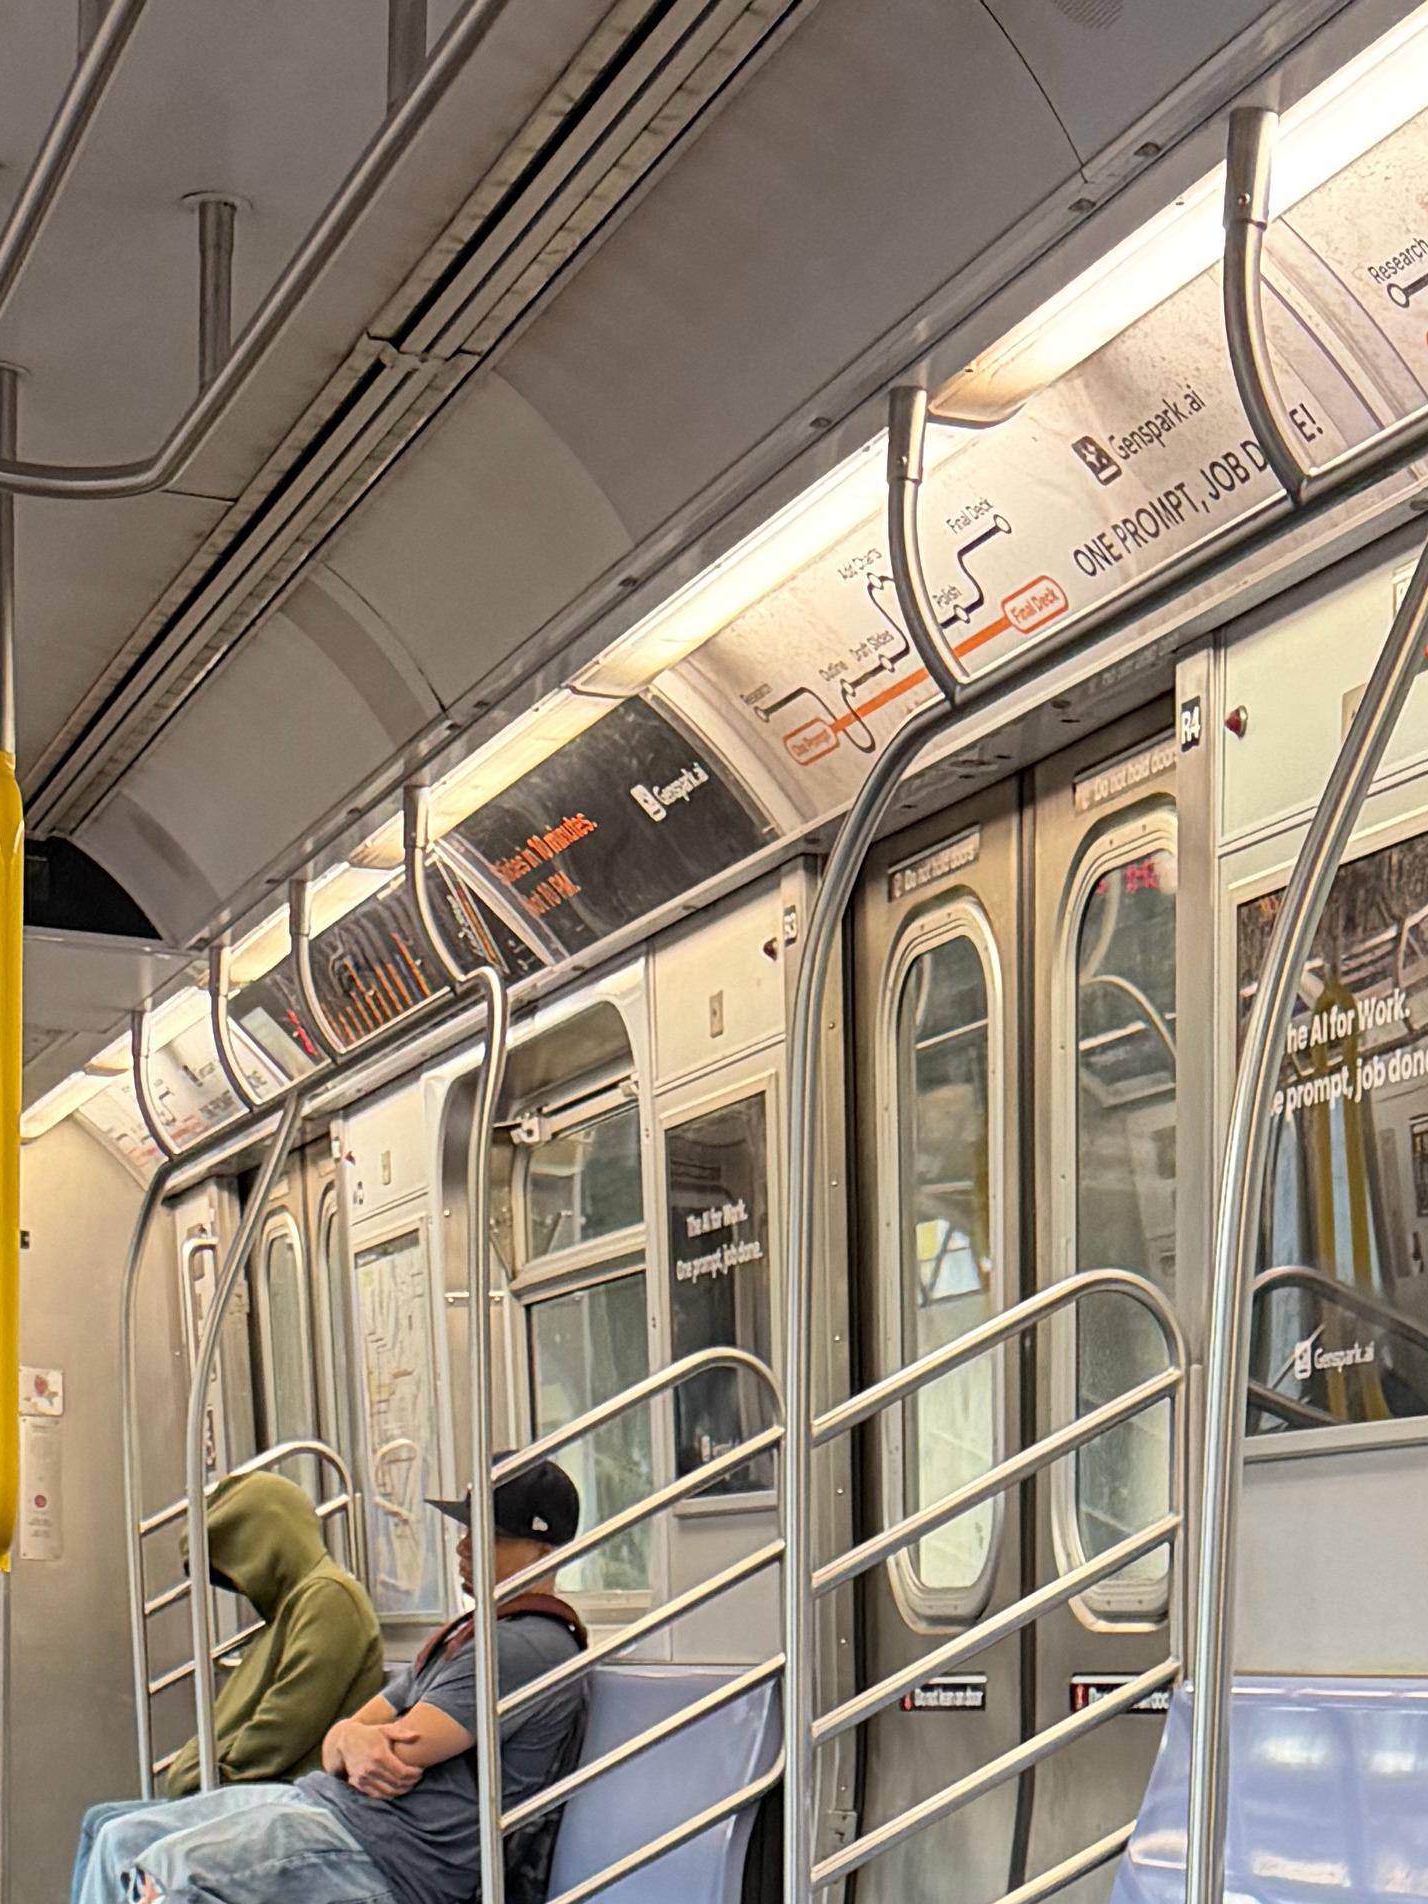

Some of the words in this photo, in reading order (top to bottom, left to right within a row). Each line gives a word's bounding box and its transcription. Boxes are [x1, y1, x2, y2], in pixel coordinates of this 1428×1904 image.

[1109, 384, 1207, 464] Genspark.ai
[1073, 531, 1123, 577] ONE
[1121, 482, 1210, 553] PROMPT,
[1206, 450, 1253, 506] JOB
[1181, 706, 1201, 745] R4
[1286, 1022, 1308, 1052] he
[1310, 1012, 1330, 1047] AI
[1329, 1004, 1356, 1038] for
[1357, 987, 1411, 1031] Work.
[1285, 1064, 1354, 1121] prompt,
[1354, 1055, 1388, 1103] job
